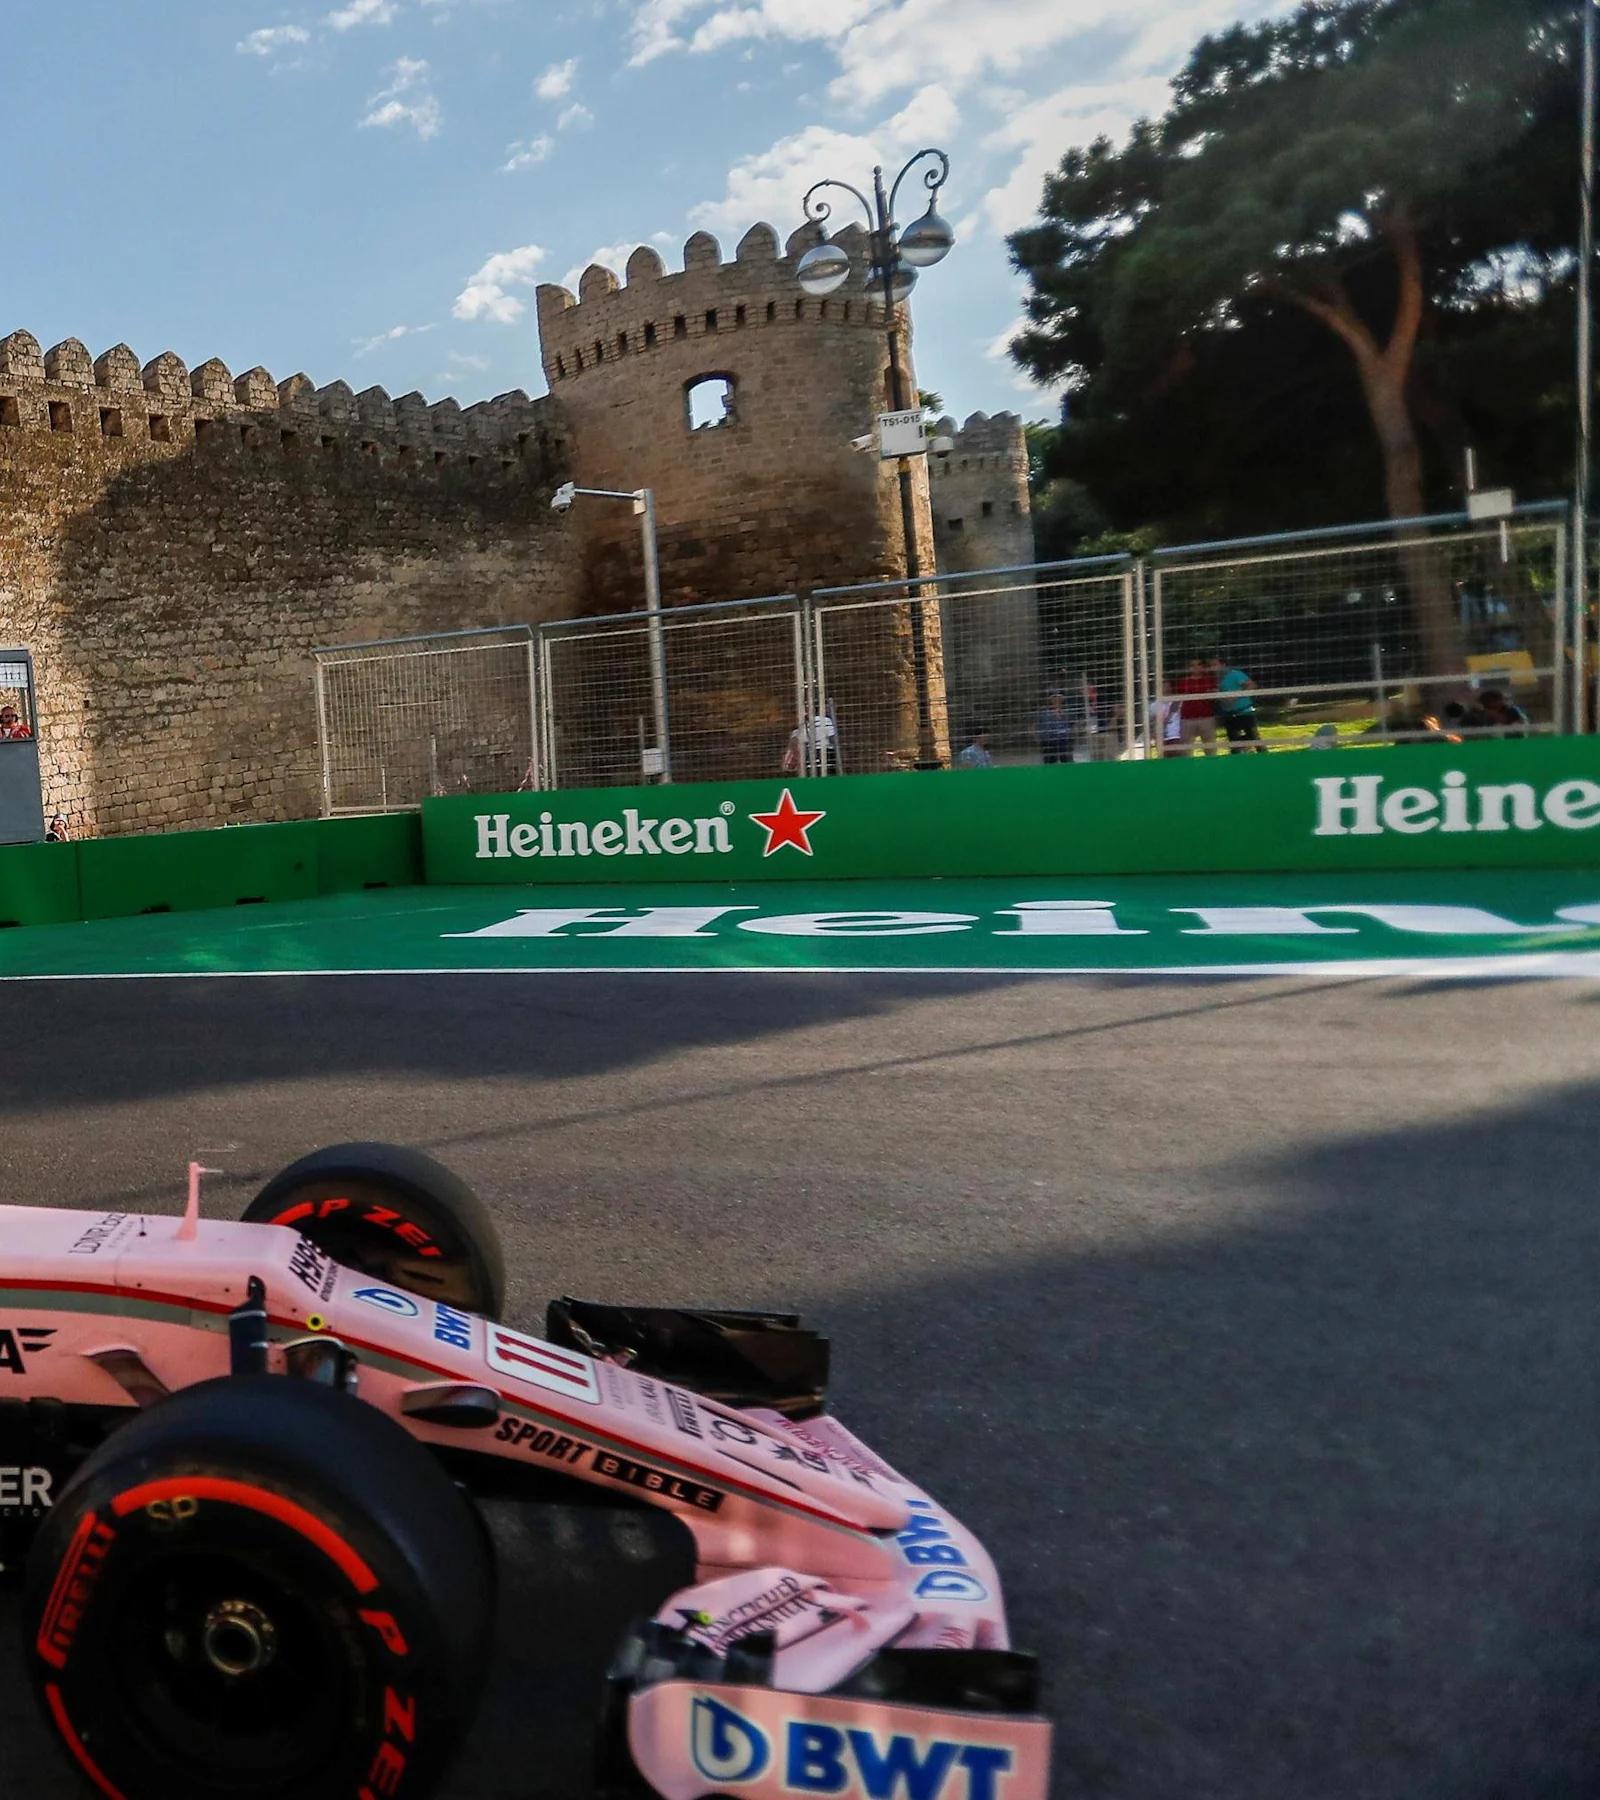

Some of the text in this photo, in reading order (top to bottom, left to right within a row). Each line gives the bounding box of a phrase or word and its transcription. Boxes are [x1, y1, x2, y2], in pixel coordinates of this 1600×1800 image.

[474, 809, 733, 858] Heineken
[439, 900, 1600, 938] Hein
[433, 1302, 472, 1351] BWT
[494, 1333, 591, 1390] 11
[494, 1415, 724, 1511] SPORT BIBLE
[357, 1684, 417, 1800] ZE
[786, 1720, 1016, 1800] BWT
